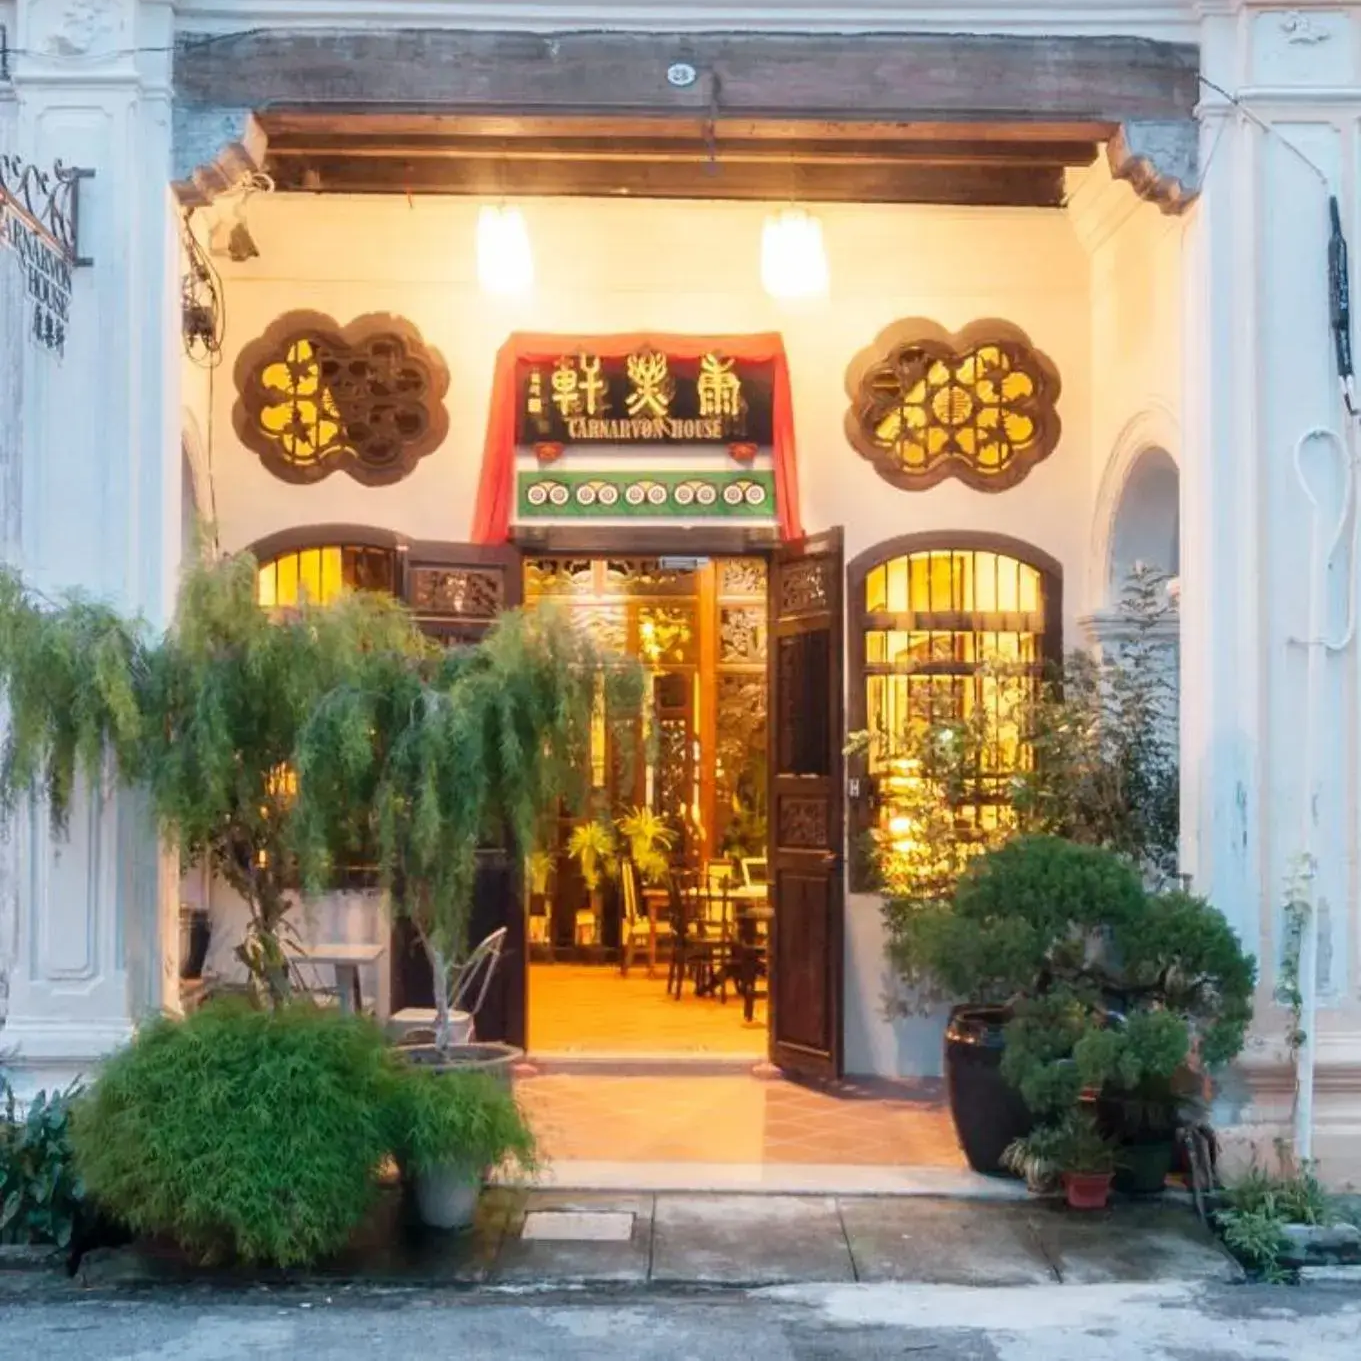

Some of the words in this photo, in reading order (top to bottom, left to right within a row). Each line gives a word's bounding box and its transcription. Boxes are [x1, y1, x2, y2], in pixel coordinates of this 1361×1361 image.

[29, 265, 70, 324] HOUSE
[567, 418, 664, 439] CARNARVON
[671, 418, 723, 439] HOUSE
